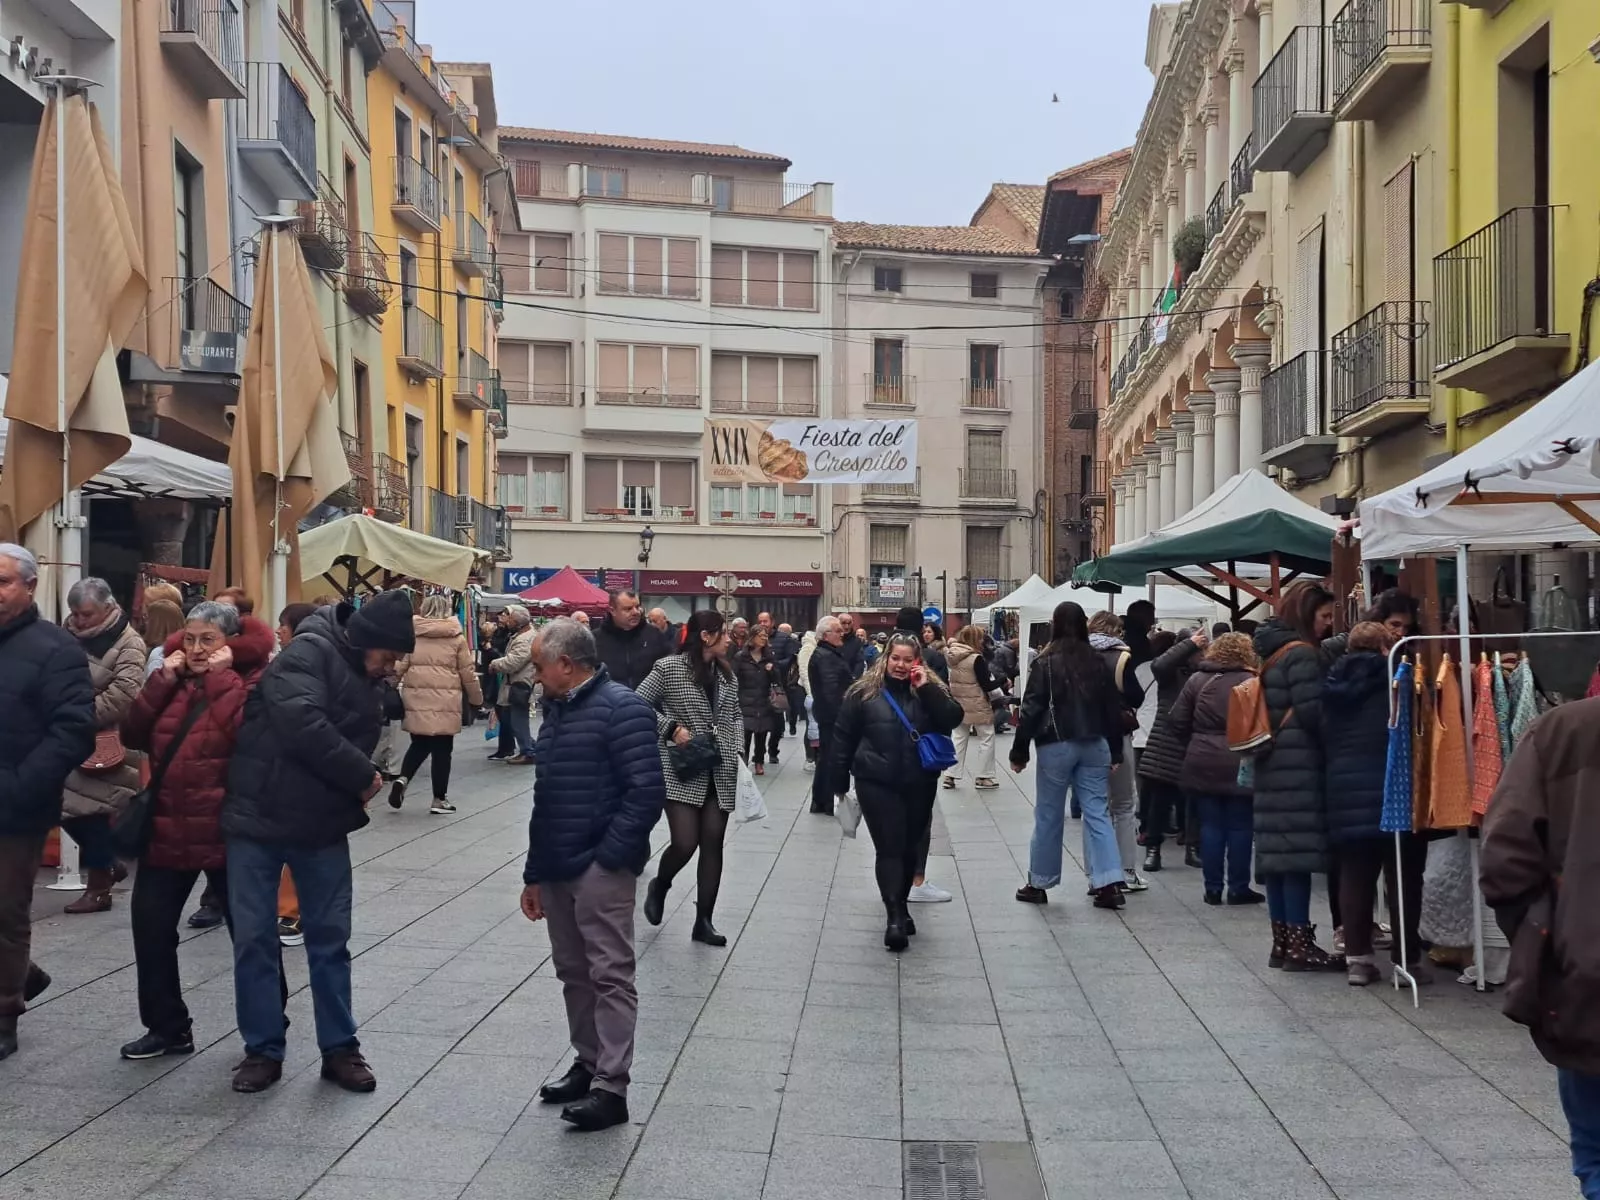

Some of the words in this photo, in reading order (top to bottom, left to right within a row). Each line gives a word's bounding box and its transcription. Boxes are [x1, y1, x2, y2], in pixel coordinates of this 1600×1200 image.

[710, 426, 750, 466] XXIX
[799, 425, 862, 447] Fiesta
[868, 424, 905, 447] del
[814, 449, 908, 477] Crespillo
